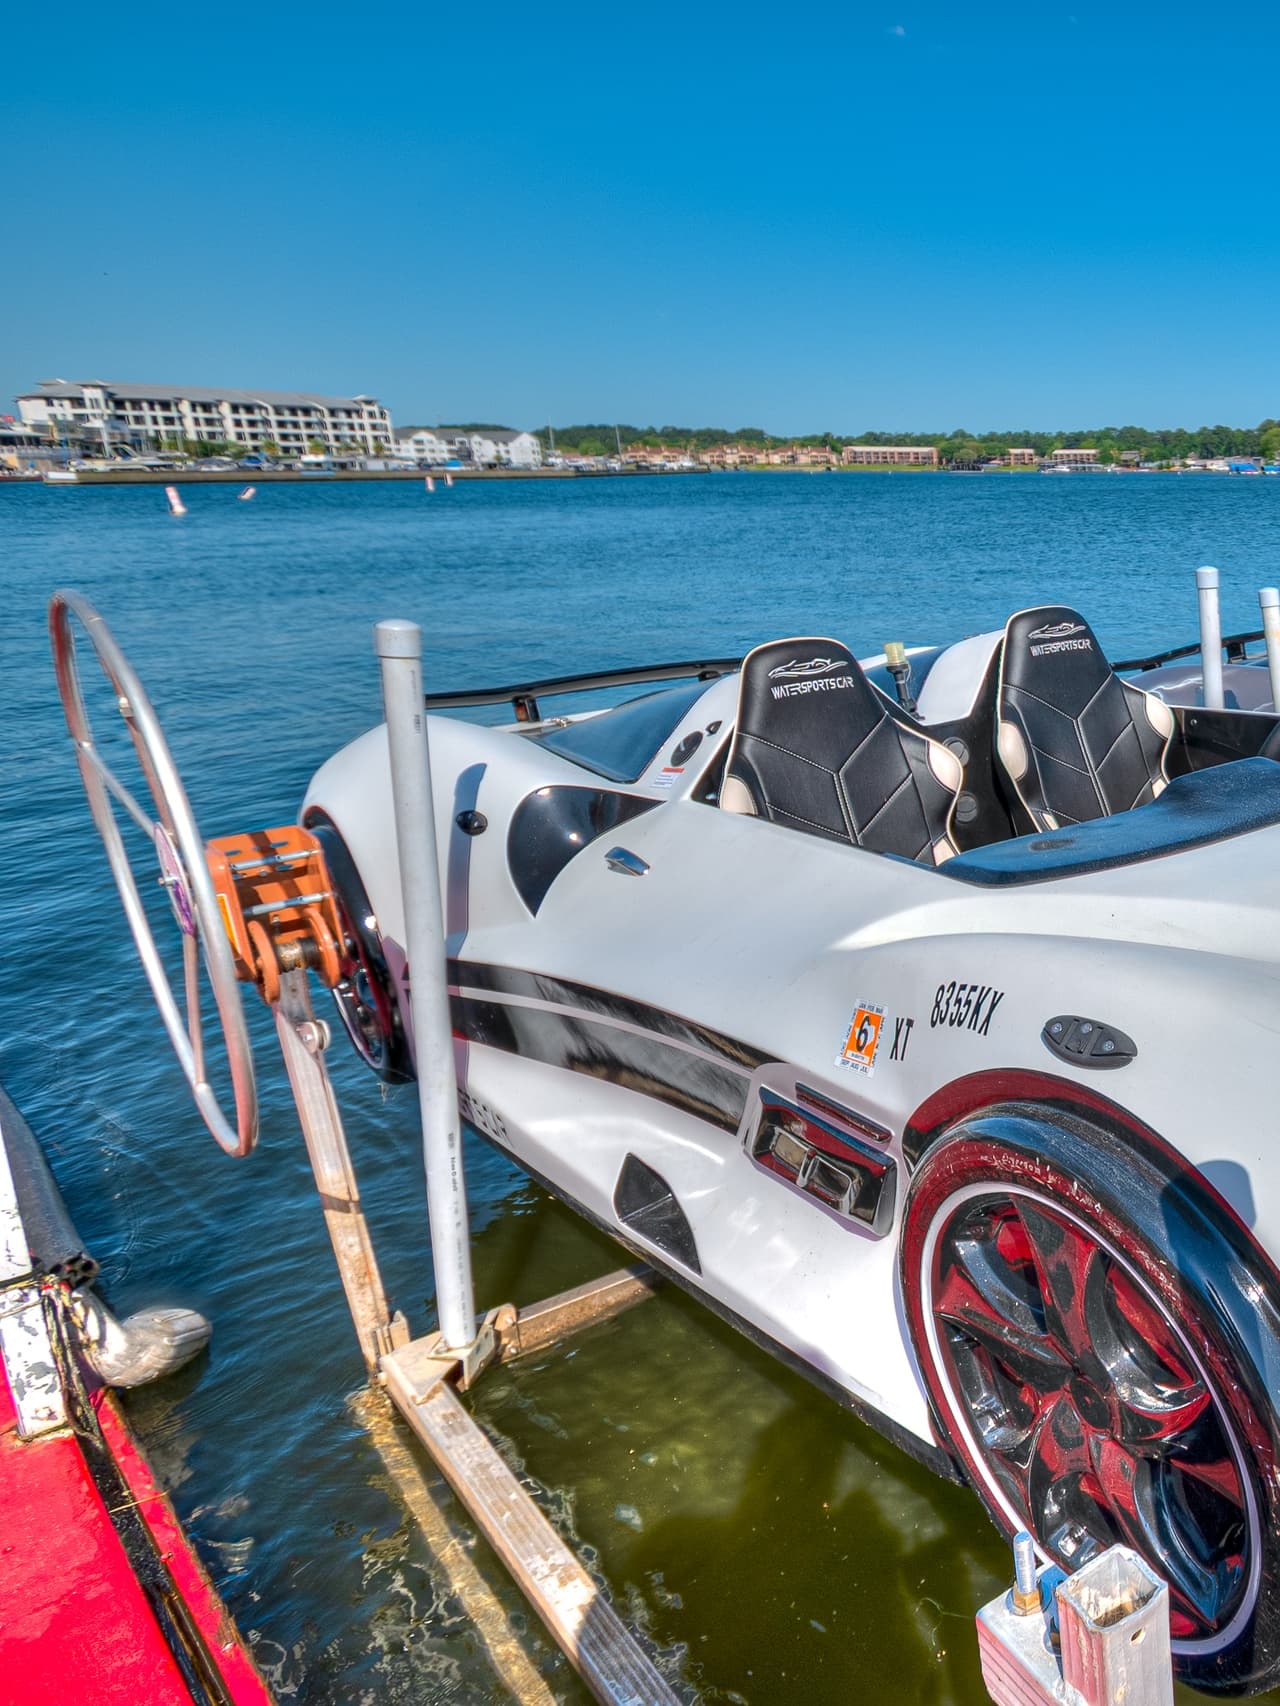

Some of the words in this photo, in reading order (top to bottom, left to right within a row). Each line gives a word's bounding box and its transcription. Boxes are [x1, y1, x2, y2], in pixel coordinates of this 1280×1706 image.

[930, 980, 1005, 1036] 8355KX
[856, 1015, 871, 1052] 6
[889, 1016, 914, 1061] XT
